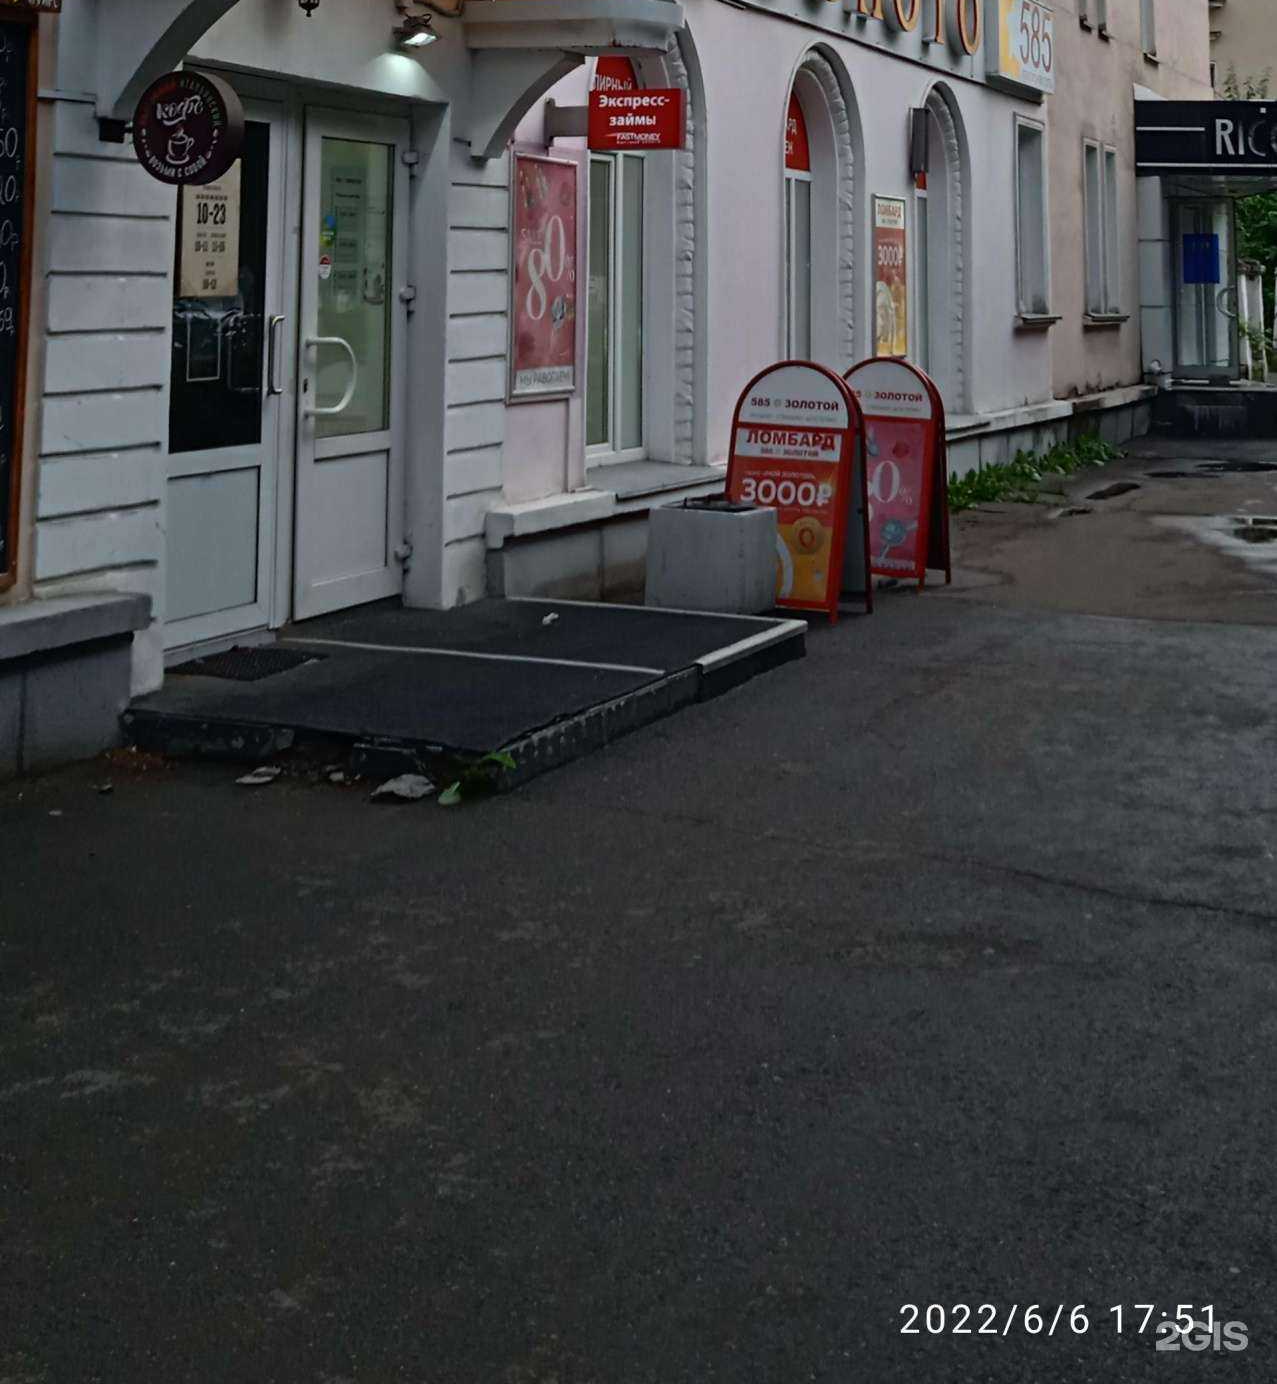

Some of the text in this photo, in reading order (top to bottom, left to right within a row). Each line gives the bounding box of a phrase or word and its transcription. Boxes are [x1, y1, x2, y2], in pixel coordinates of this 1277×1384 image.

[1020, 1, 1052, 72] 585
[594, 74, 633, 91] ЛИРНЫЙ
[598, 95, 670, 109] Экспресс-
[609, 113, 656, 126] займы
[196, 202, 226, 224] 10-23
[751, 397, 770, 407] 585
[747, 430, 836, 451] ЛОМБАРД
